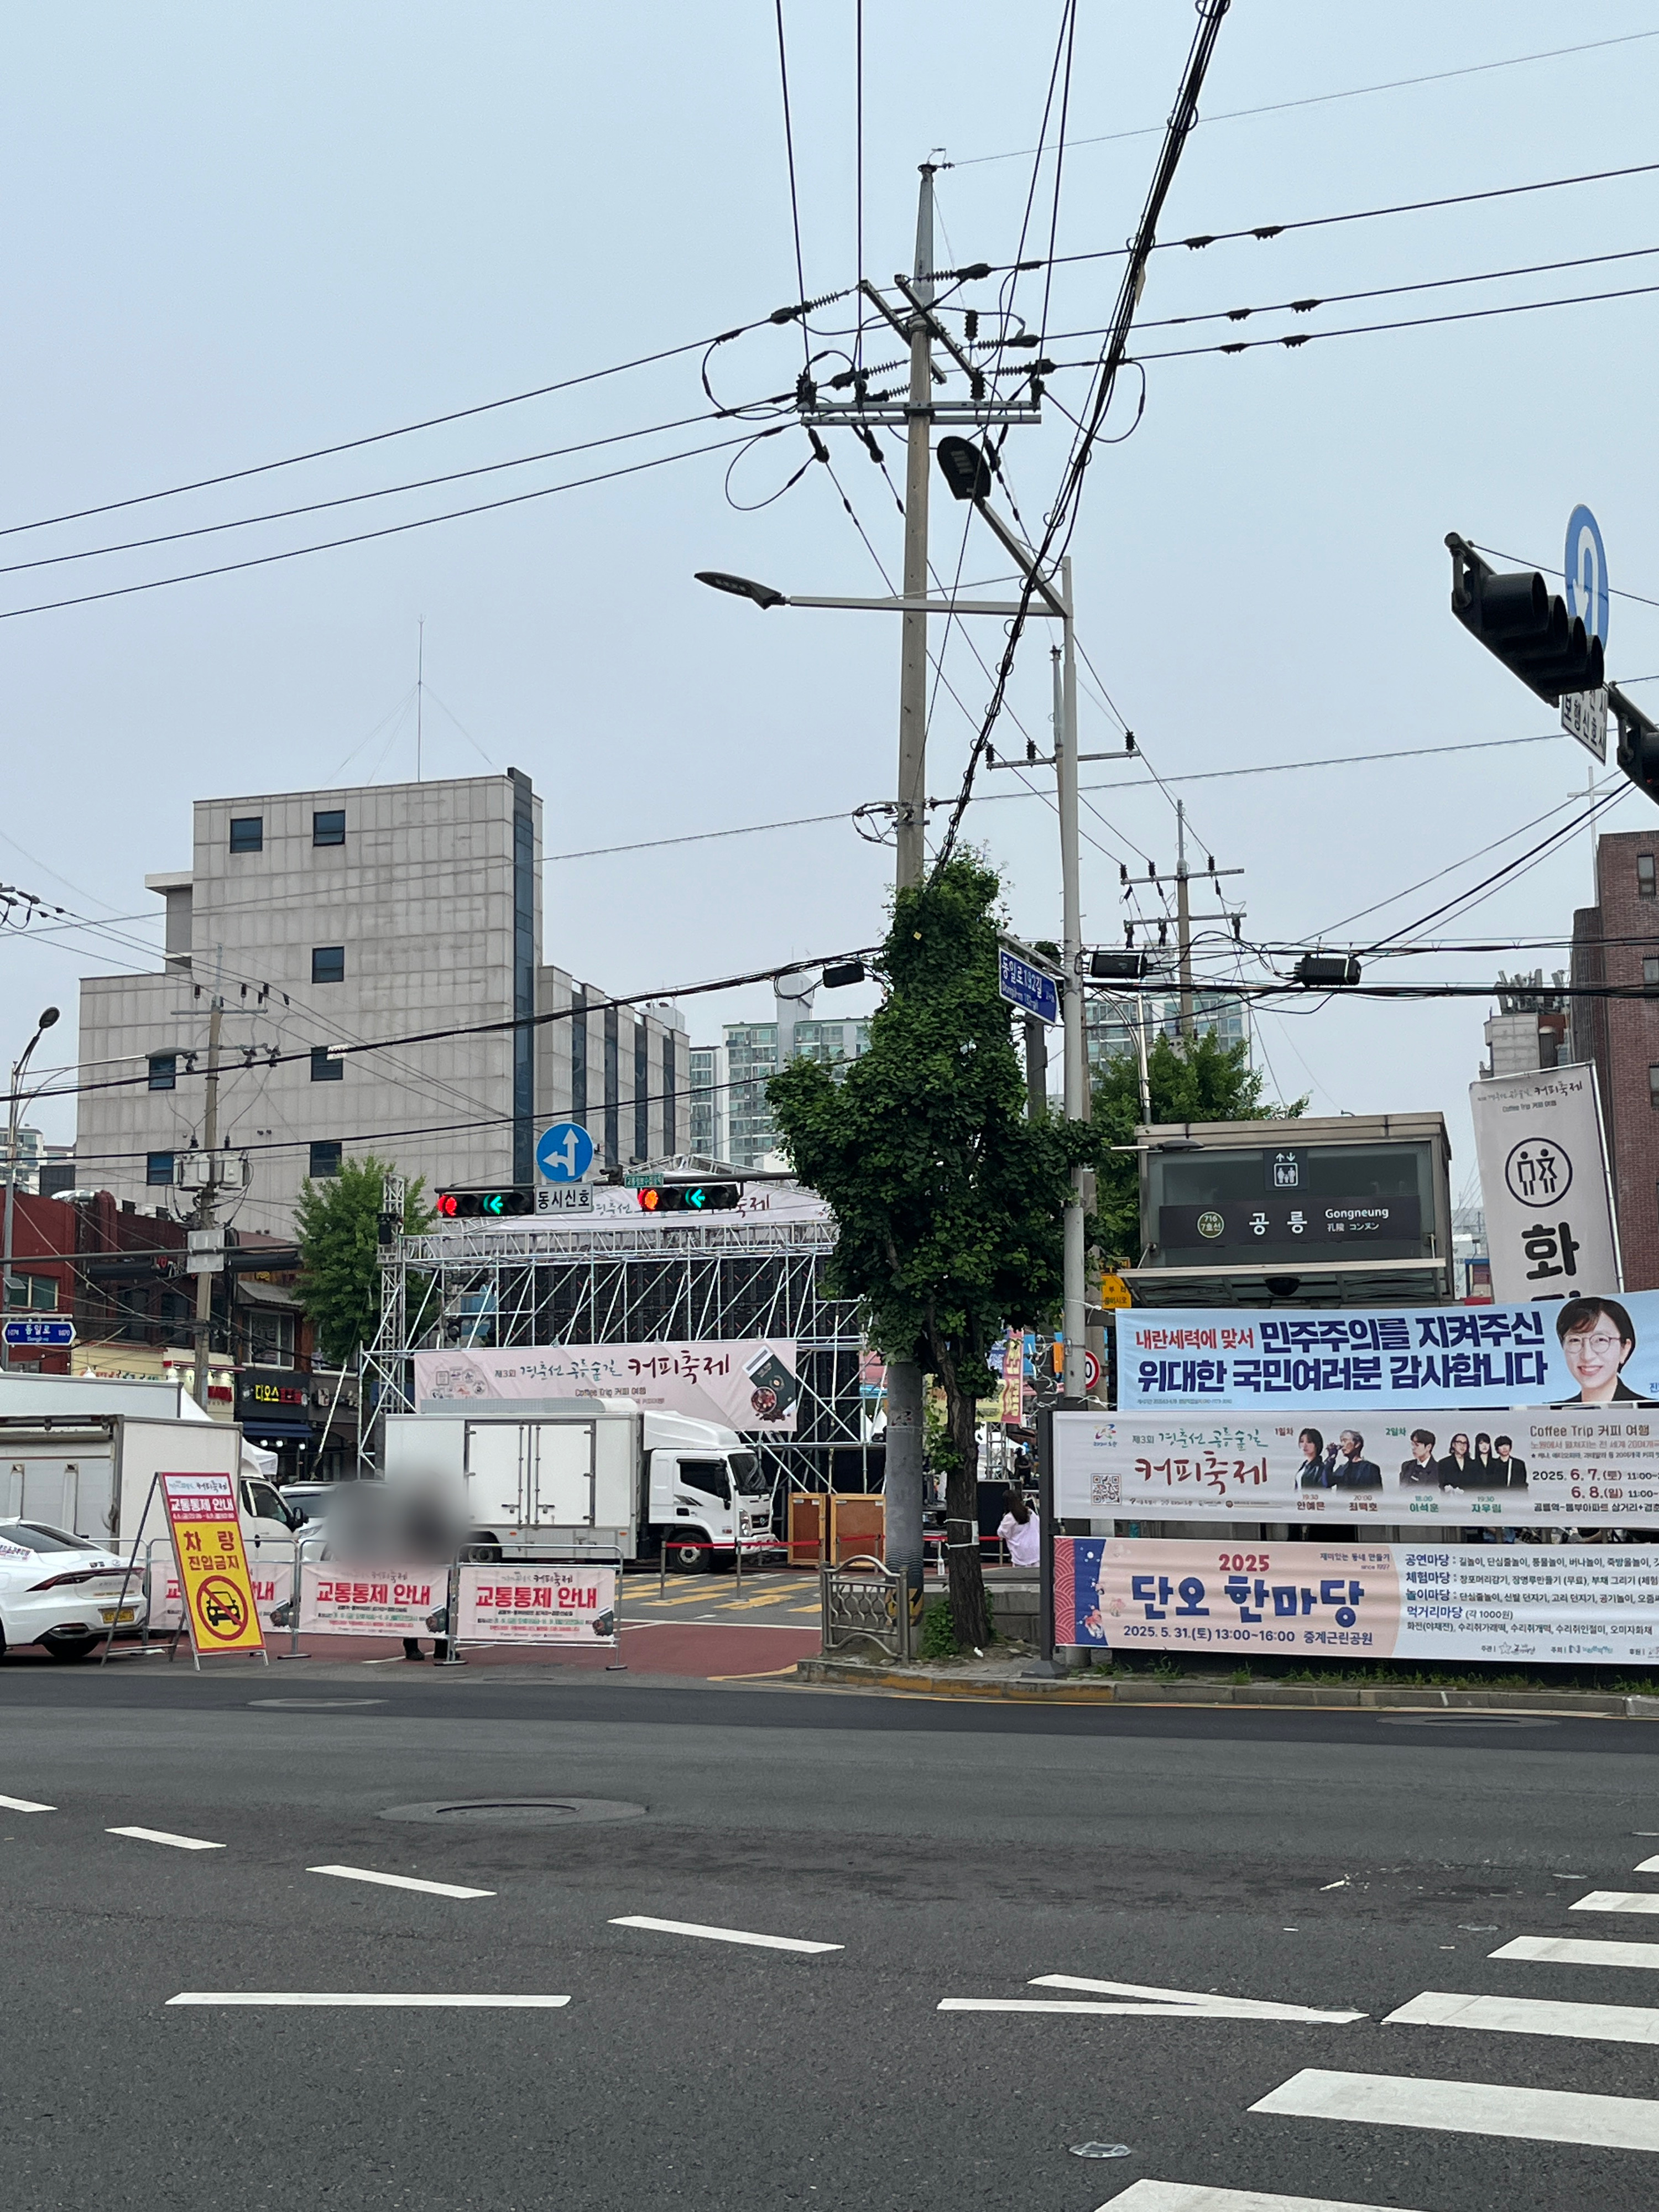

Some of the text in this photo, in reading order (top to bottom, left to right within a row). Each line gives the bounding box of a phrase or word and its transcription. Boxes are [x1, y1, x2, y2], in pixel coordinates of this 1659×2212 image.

[1001, 956, 1042, 999] 동일로192길
[1534, 1081, 1583, 1096] 커피축제
[538, 1190, 590, 1209] 동시신호
[1325, 1208, 1389, 1220] Gongneung
[25, 1324, 51, 1335] 동일로
[1135, 1311, 1546, 1354] 내란세력에 맞서 민주주의를 지켜주신
[628, 1350, 729, 1385] 커피축제
[1137, 1350, 1549, 1393] 위대한 국민여러분 감사합니다
[575, 1388, 597, 1397] Coffee
[614, 1387, 629, 1396] 커피
[1275, 1427, 1293, 1437] 1일차
[1385, 1426, 1406, 1437] 2일차
[1530, 1424, 1650, 1438] Coffee Trip 커피 여행
[1132, 1427, 1268, 1451] 제3회 경춘선 공릉숲길
[1134, 1450, 1267, 1495] 커피축제
[1532, 1470, 1567, 1481] 2025.
[169, 1498, 234, 1511] 교통통제 안내
[1296, 1501, 1326, 1511] 안예은
[1409, 1503, 1439, 1513] 이석훈
[1471, 1503, 1501, 1514] 자우림
[187, 1555, 239, 1571] 진입금지
[1219, 1553, 1270, 1572] 2025
[1320, 1553, 1390, 1562] 재미있는 동네 만들기
[1405, 1554, 1449, 1567] 공연마당
[1459, 1557, 1485, 1568] 길놀이,
[1487, 1557, 1530, 1568] 단심줄놀이,
[1532, 1557, 1567, 1568] 풍물놀이,
[1569, 1557, 1605, 1568] 버나놀이,
[1607, 1557, 1651, 1568] 죽방울놀이,
[533, 1572, 573, 1586] 커피축제
[1406, 1571, 1451, 1584] 체험마당
[1459, 1575, 1510, 1585] 창포머리감기,
[1563, 1575, 1589, 1587] (무료),
[1592, 1575, 1608, 1585] 부채
[1610, 1575, 1636, 1585] 그리기
[317, 1582, 431, 1605] 교통통제 안내
[476, 1586, 597, 1609] 교통통제 안내
[1406, 1588, 1450, 1601] 놀이마당
[1459, 1593, 1503, 1603] 단심줄놀이,
[1505, 1594, 1520, 1603] 신발
[1522, 1594, 1550, 1604] 던지기,
[1552, 1594, 1568, 1603] 고리
[1571, 1594, 1598, 1604] 던지기,
[1600, 1594, 1635, 1604] 공기놀이,
[1131, 1575, 1365, 1627] 단오 한마당
[1407, 1606, 1513, 1620] 먹거리마당 (각 1000원)
[1124, 1626, 1373, 1646] 2025. 5. 31.(토) 13:00~16:00 중계근린공원
[1556, 1624, 1608, 1635] 수리취인절미,
[1610, 1625, 1652, 1635] 오미자화채
